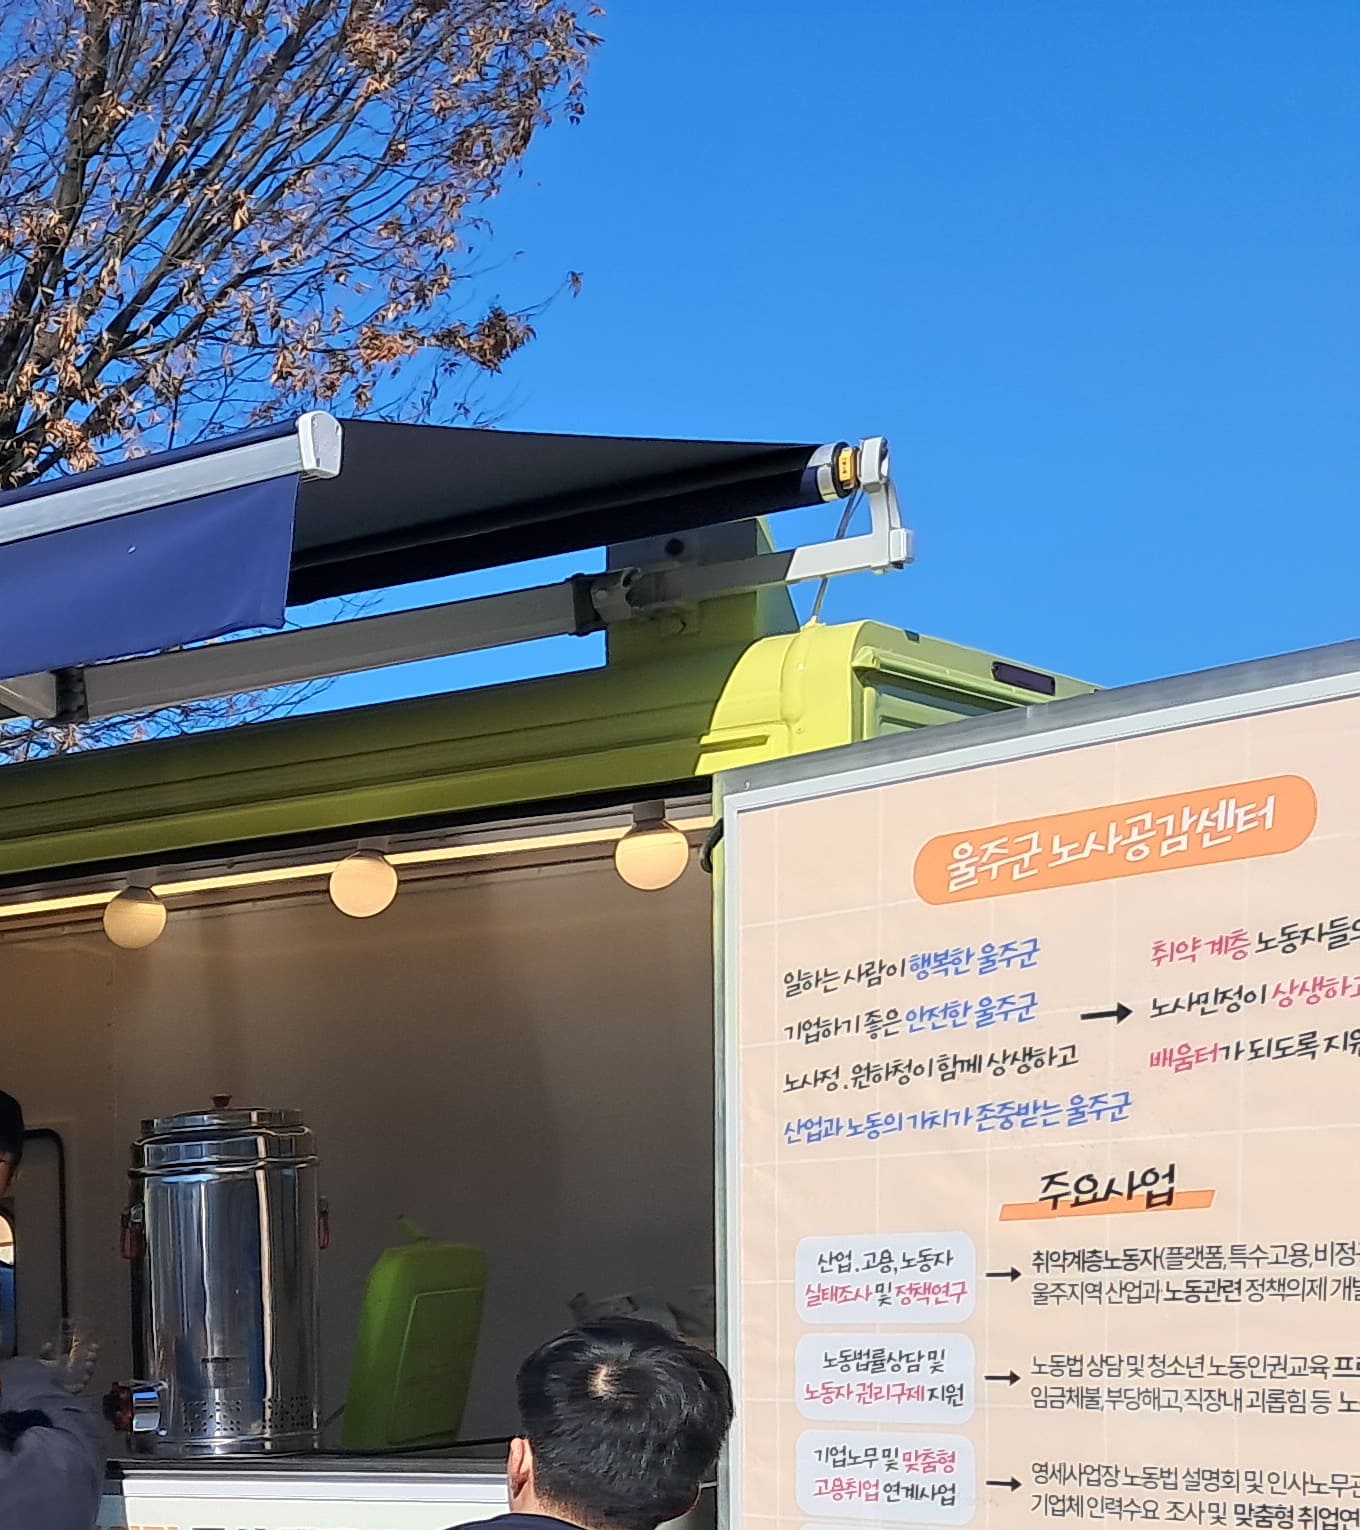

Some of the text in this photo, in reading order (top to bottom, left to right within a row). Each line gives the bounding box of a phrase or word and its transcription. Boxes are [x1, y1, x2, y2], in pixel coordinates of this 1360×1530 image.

[947, 795, 1275, 893] 울주군 노사공감센터
[1151, 937, 1201, 967] 취약
[1204, 928, 1252, 961] 계층
[784, 938, 1040, 997] 일하는 사람이 행복한 울주군
[784, 991, 1038, 1044] 기업하기 좋은 안전한 울주군
[1150, 984, 1267, 1019] 노사민정이
[936, 1054, 983, 1082] 함께
[986, 1044, 1079, 1077] 상생하고
[1149, 1041, 1244, 1074] 배움터가
[1247, 1030, 1319, 1061] 되도록
[784, 1091, 1133, 1145] 산업과 노동의 가치가 존중받는 울주군
[1038, 1163, 1176, 1211] 주요사업
[805, 1281, 968, 1308] 실태조사 및 정책연구
[1032, 1282, 1102, 1306] 울주지역
[1106, 1279, 1160, 1305] 산업과
[1163, 1278, 1242, 1304] 노동관련
[1246, 1276, 1327, 1303] 정책의제
[822, 1348, 945, 1374] 노동법률상담 및
[1031, 1354, 1084, 1378] 노동법
[1087, 1354, 1124, 1378] 상담
[1127, 1354, 1145, 1379] 및
[1147, 1354, 1205, 1378] 청소년
[1207, 1354, 1330, 1380] 노동인권교육
[804, 1381, 964, 1408] 노동자 권리구제 지원
[1246, 1389, 1307, 1414] 괴롭힘
[1310, 1390, 1331, 1415] 등
[814, 1445, 956, 1474] 기업노무 및 맞춤형
[812, 1477, 956, 1507] 고용취업 연계사업
[1031, 1462, 1121, 1488] 영세사업장
[1123, 1466, 1178, 1491] 노동법
[1182, 1467, 1239, 1493] 설명회
[1244, 1469, 1264, 1494] 및
[1031, 1494, 1084, 1519] 기업체
[1087, 1496, 1160, 1522] 인력수요
[1165, 1501, 1206, 1526] 조사
[1208, 1502, 1228, 1527] 및
[1234, 1504, 1294, 1530] 맞춤형
